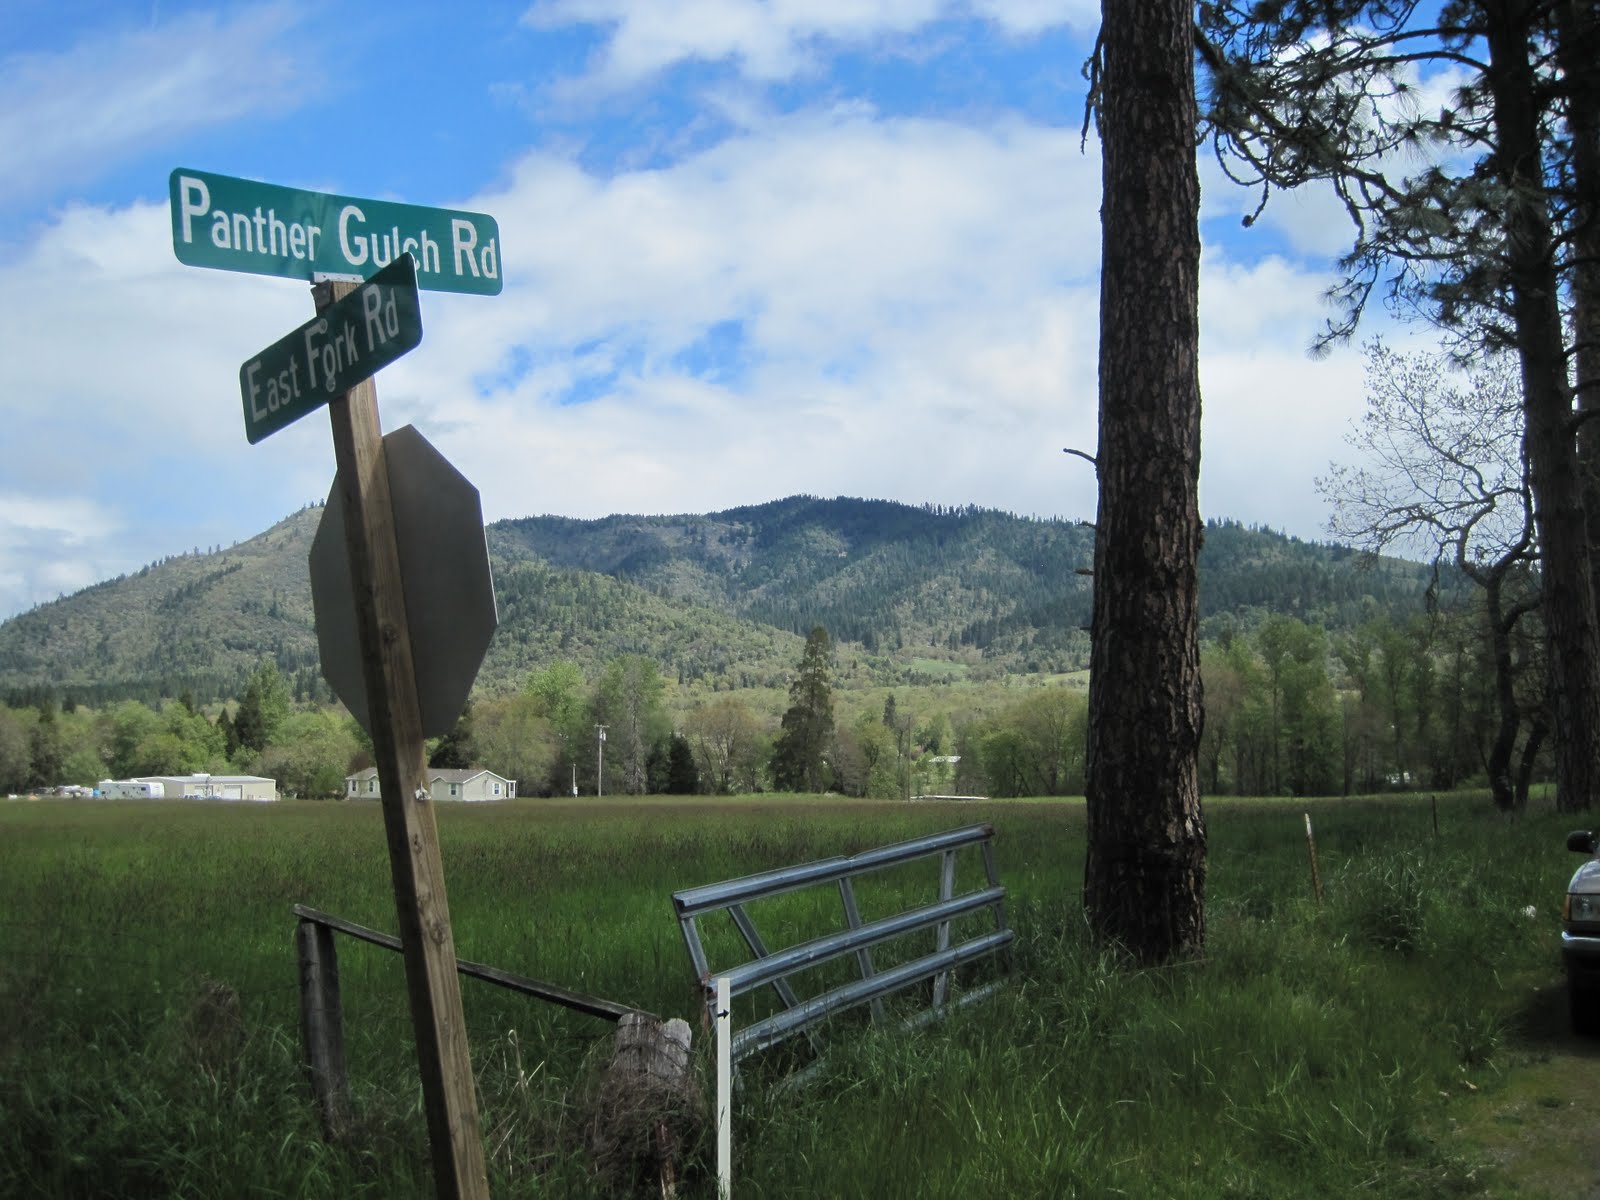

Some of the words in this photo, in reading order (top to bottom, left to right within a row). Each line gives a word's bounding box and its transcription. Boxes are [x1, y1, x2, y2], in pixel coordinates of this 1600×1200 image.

[179, 175, 322, 262] Panther
[338, 205, 441, 274] Gulch
[451, 218, 499, 280] Rd
[246, 360, 301, 424] East
[304, 317, 360, 389] Fork
[362, 283, 400, 352] Rd
